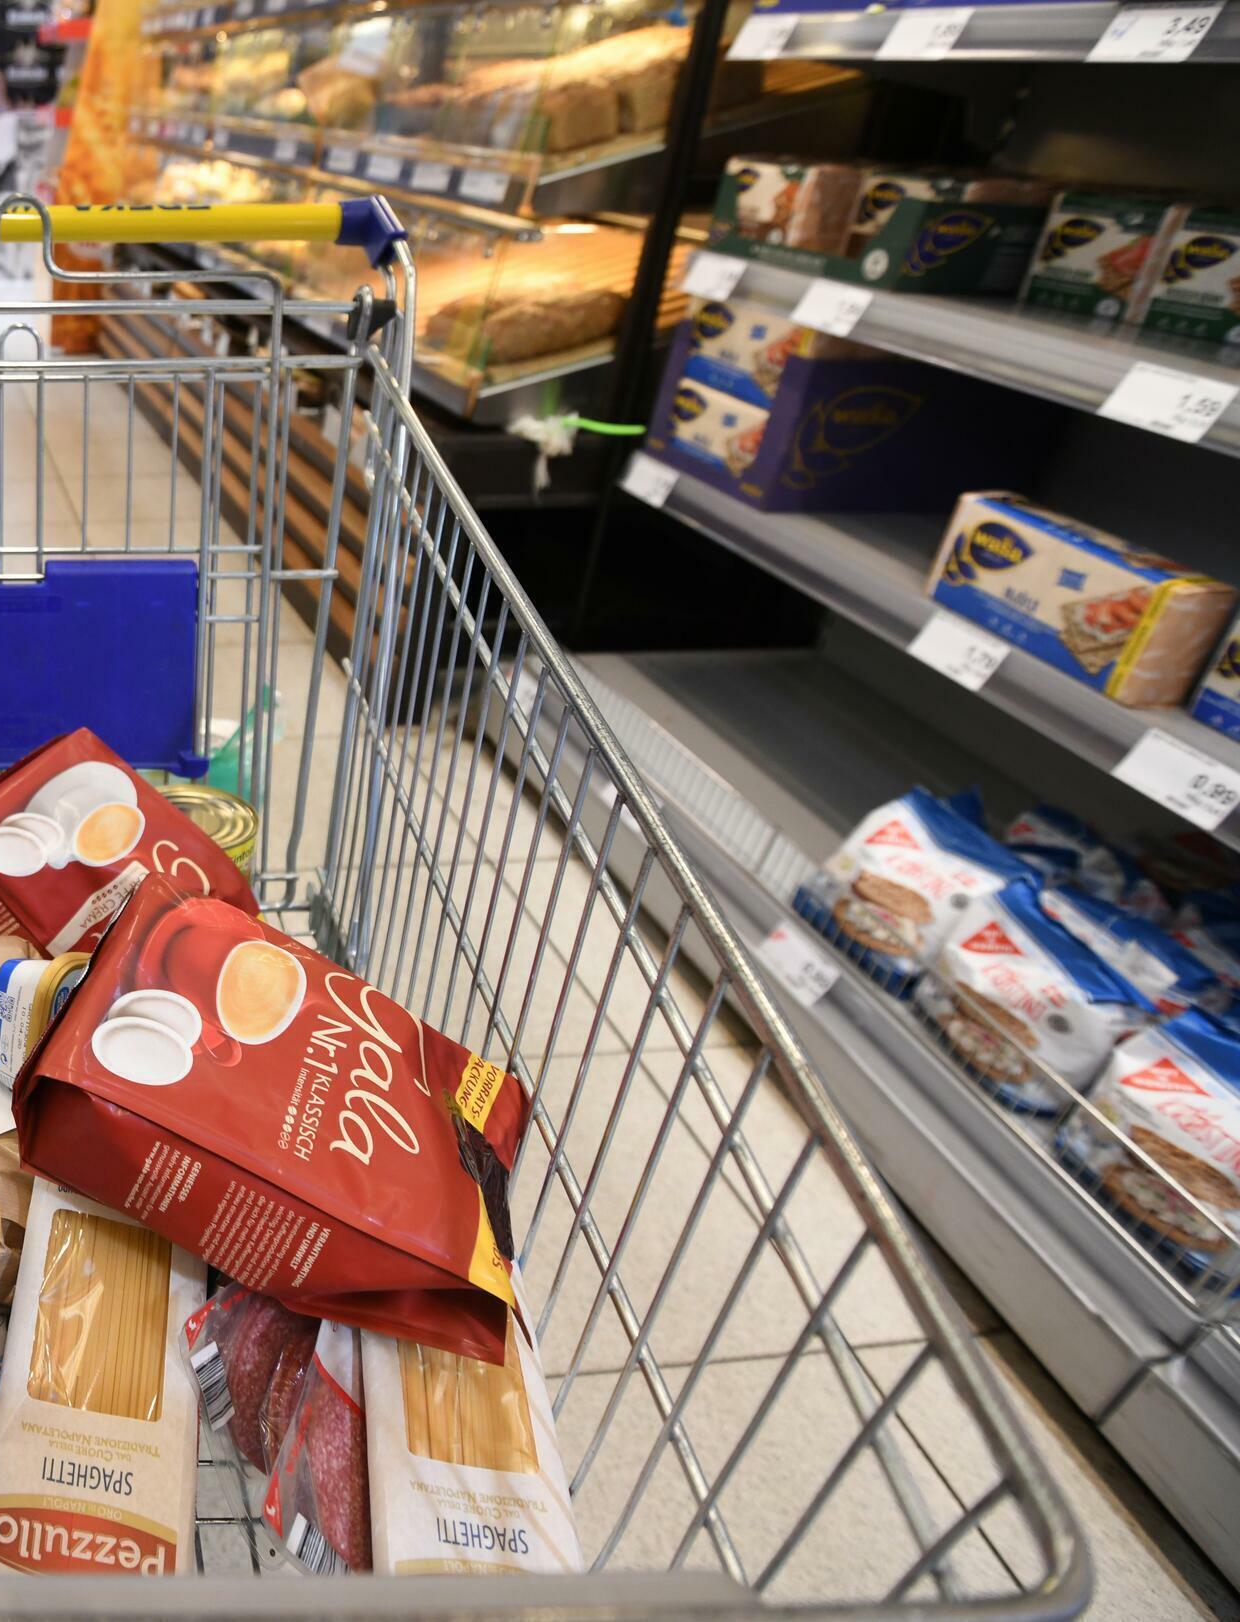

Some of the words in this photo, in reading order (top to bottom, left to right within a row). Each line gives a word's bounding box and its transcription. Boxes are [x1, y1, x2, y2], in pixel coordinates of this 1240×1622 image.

[79, 897, 117, 931] CREMA
[326, 973, 431, 1165] Gala
[457, 1058, 483, 1106] ACKUNG
[291, 1069, 307, 1105] Intensität
[469, 1065, 499, 1119] VORRATS-
[294, 1074, 329, 1160] KLASSISCH
[158, 1156, 192, 1213] INFORMATIONEN
[177, 1161, 202, 1204] GENIESSER-
[274, 1214, 307, 1260] Verantwortung
[305, 1221, 320, 1240] UND
[288, 1238, 311, 1269] UMWELT
[290, 1227, 332, 1289] VERANTWORTUNG
[20, 1421, 93, 1444] NAPOLETANA
[48, 1440, 74, 1452] DELLA
[92, 1437, 161, 1457] TRADIZIONE
[74, 1447, 114, 1461] CUORE
[115, 1452, 131, 1462] DAL
[41, 1457, 133, 1495] SPAGHETTI
[409, 1479, 478, 1502] NAPOLETANA
[42, 1496, 86, 1513] NAPOLI
[97, 1507, 122, 1520] ORO
[463, 1503, 502, 1519] CUORE
[478, 1493, 548, 1512] TRADIZIONE
[437, 1517, 527, 1554] SPAGHETTI
